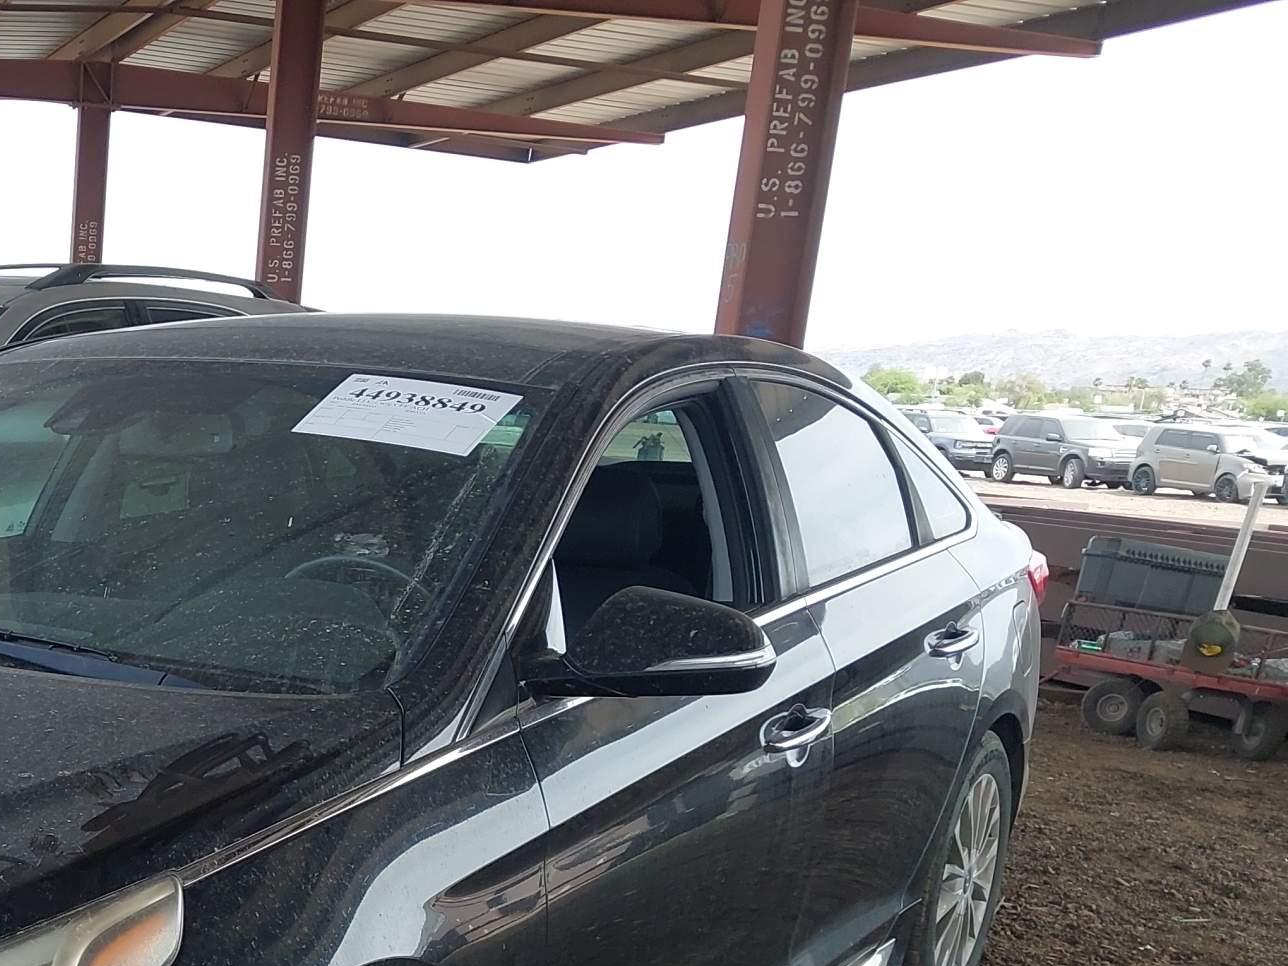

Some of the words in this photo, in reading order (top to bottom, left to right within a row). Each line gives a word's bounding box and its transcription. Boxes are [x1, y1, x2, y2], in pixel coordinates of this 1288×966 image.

[767, 49, 799, 152] PREFAB
[780, 0, 829, 217] 1-866-799-096
[274, 152, 288, 181] INC.
[270, 189, 285, 246] PREFAB
[280, 154, 301, 282] 1-866-799-0969
[757, 170, 781, 218] U.S.
[267, 255, 280, 282] U.S.
[349, 387, 487, 414] 44938849
